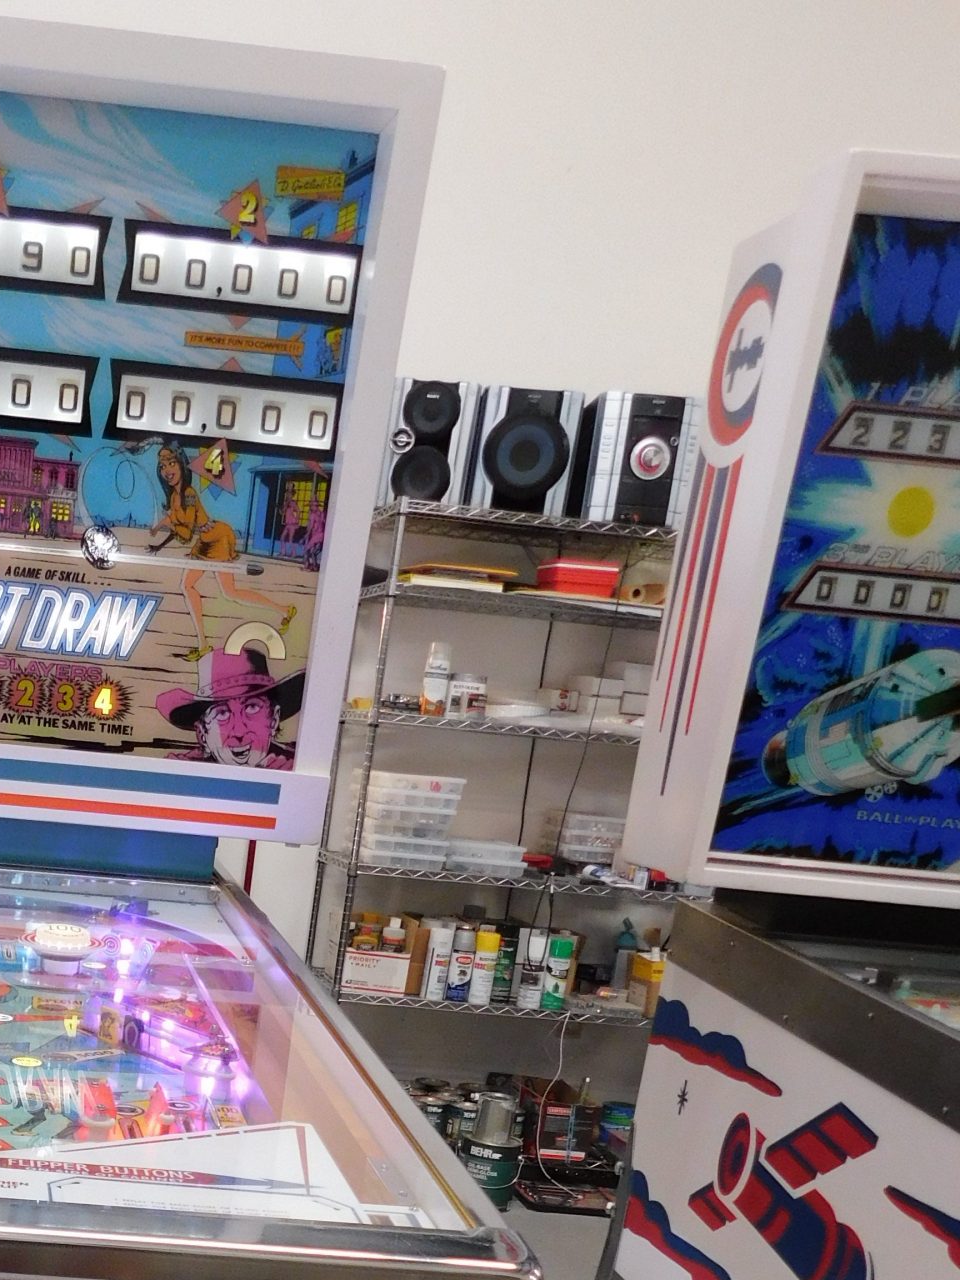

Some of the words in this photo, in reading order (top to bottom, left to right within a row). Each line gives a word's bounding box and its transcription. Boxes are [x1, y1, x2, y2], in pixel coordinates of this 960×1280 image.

[239, 191, 259, 225] 2
[205, 447, 225, 478] 4
[5, 568, 13, 577] A
[14, 568, 42, 579] GAME
[45, 570, 58, 581] OF
[18, 586, 162, 661] DRAW
[16, 679, 35, 708] 2
[57, 683, 76, 712] 3
[94, 688, 113, 715] 4
[18, 713, 31, 726] AT
[34, 716, 59, 729] THE
[61, 718, 95, 733] SAME
[99, 721, 134, 737] TIME!
[856, 809, 902, 825] BALL
[348, 955, 380, 964] PRIORITY
[470, 1146, 493, 1158] BEHR
[8, 1157, 90, 1173] FLIPPER
[100, 1165, 195, 1180] BUTTONS
